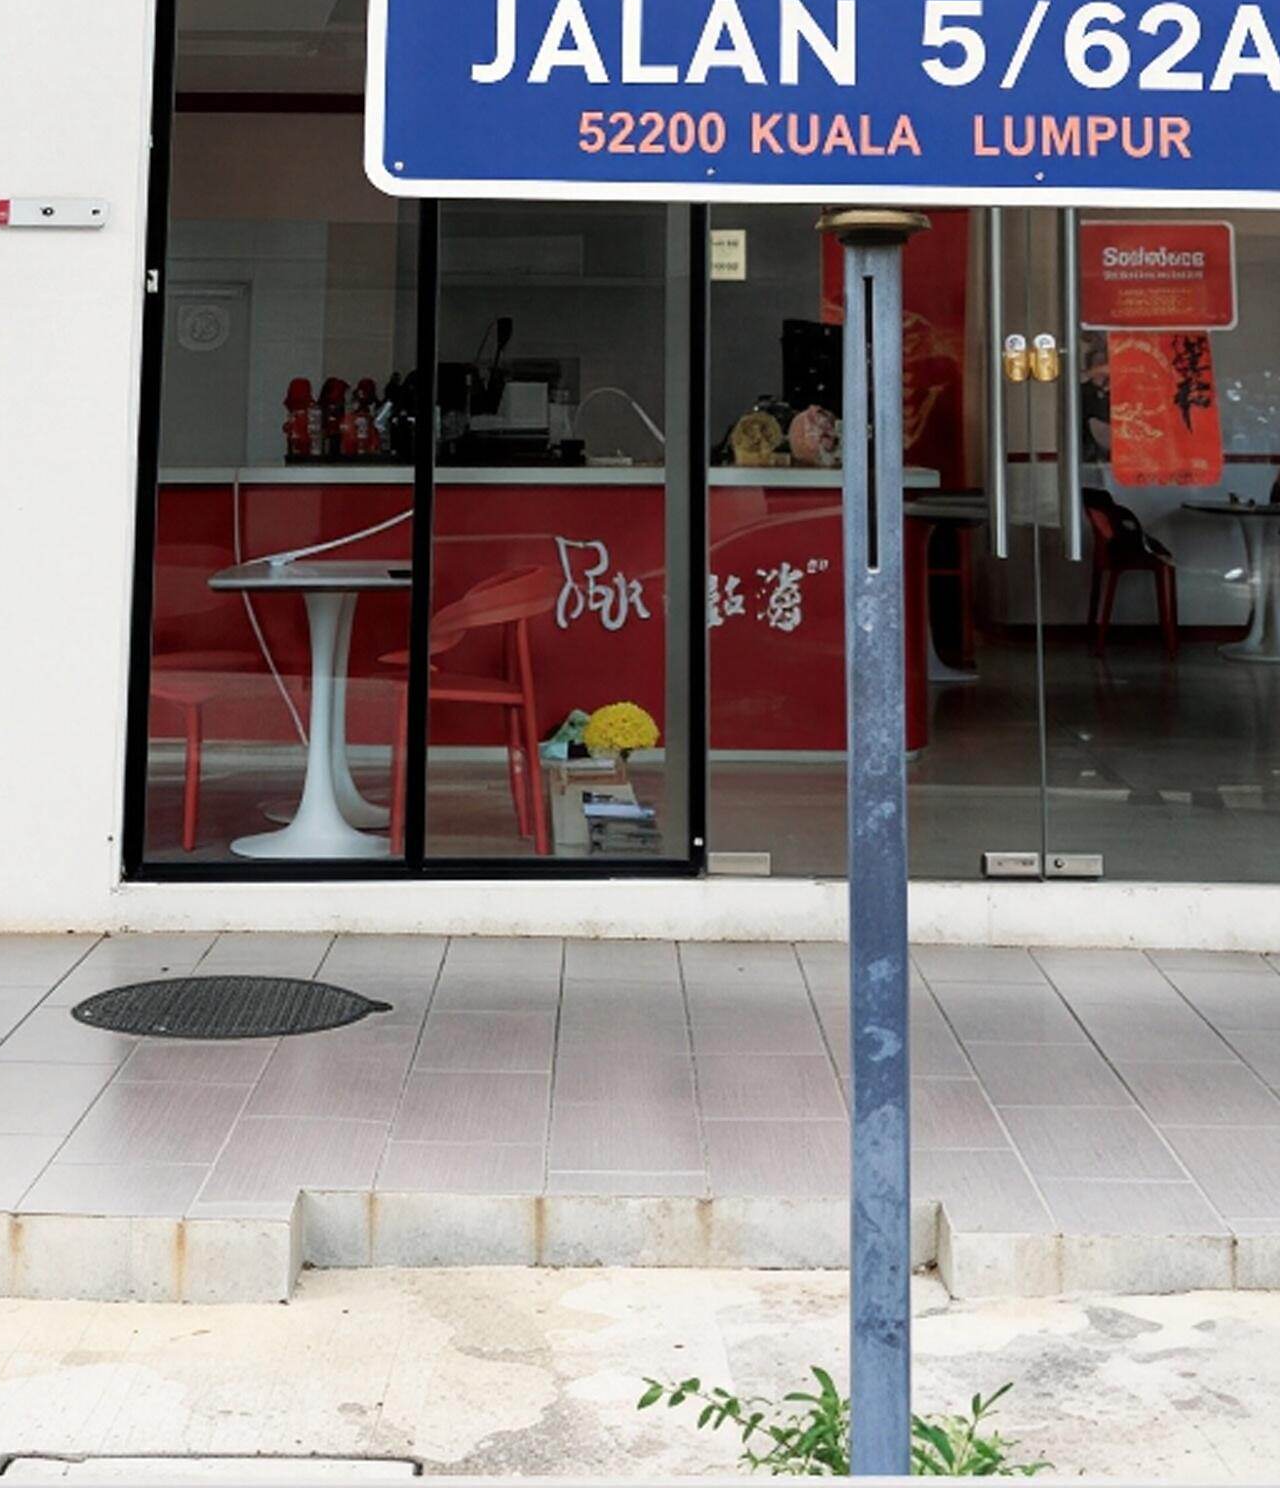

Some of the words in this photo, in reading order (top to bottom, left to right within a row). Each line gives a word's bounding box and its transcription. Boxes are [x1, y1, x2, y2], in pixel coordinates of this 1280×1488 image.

[577, 111, 726, 155] 52200
[750, 112, 922, 157] KUALA
[973, 115, 1192, 159] LUMPUR
